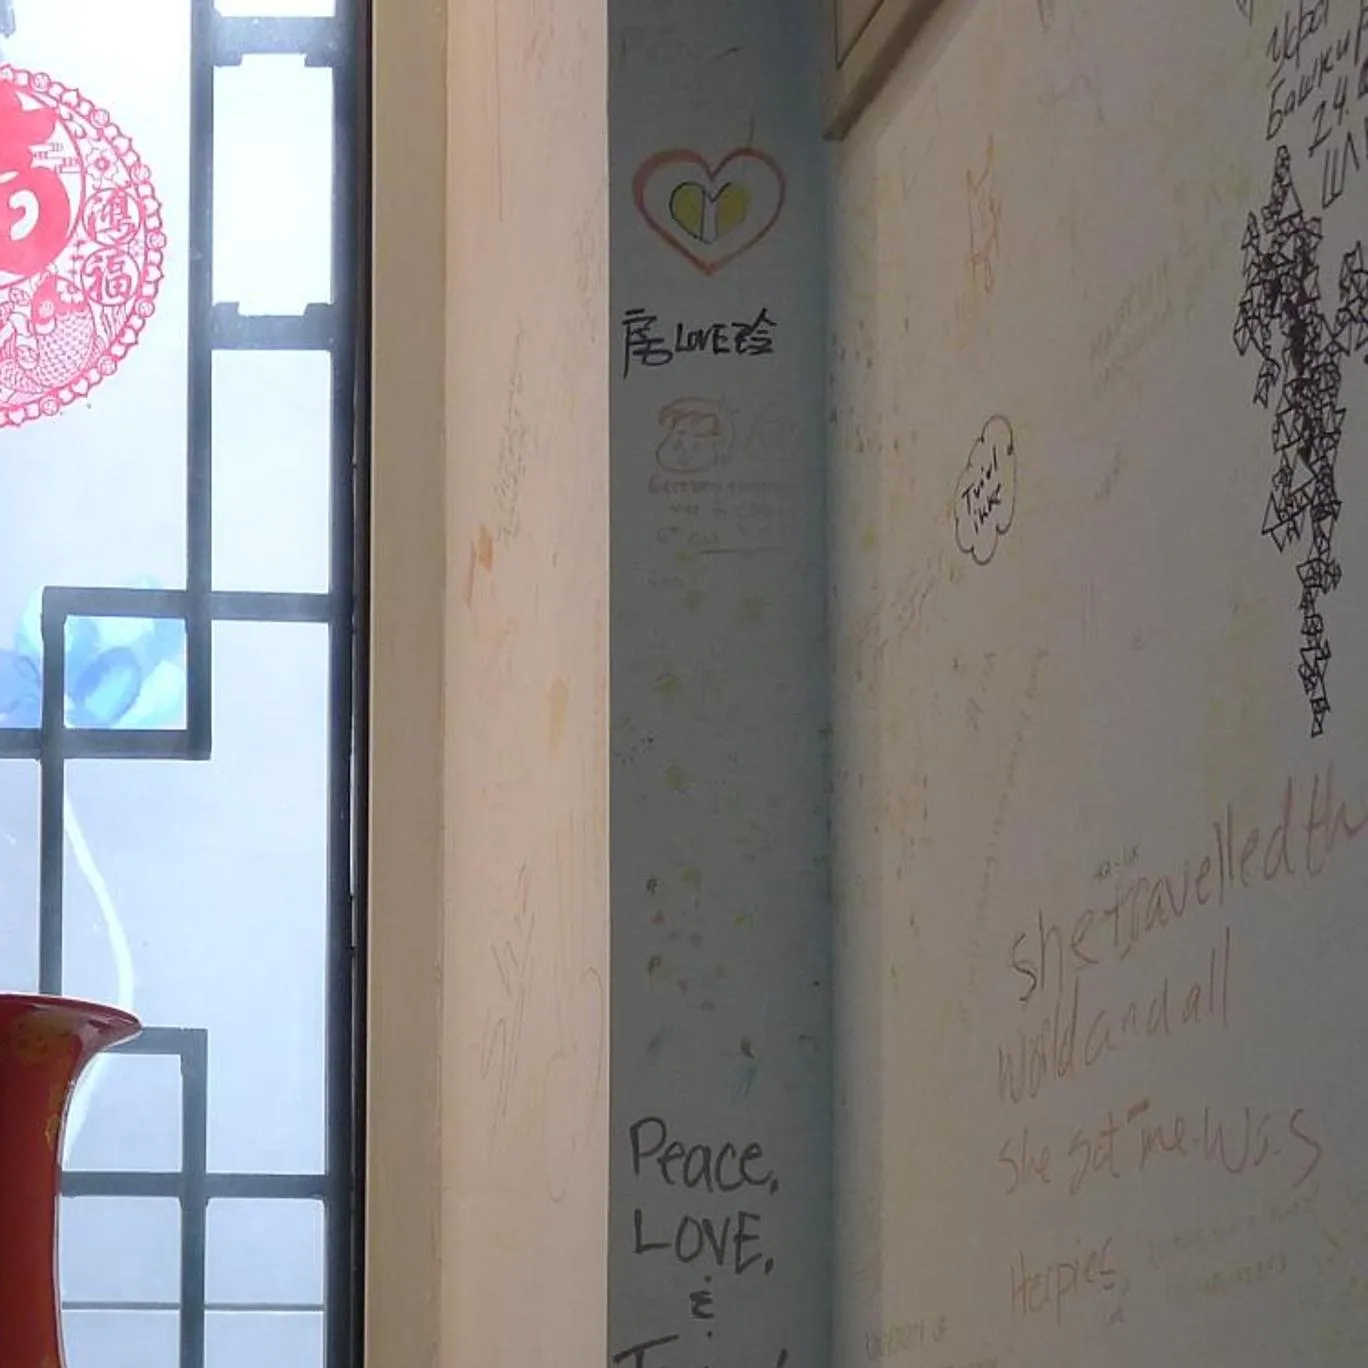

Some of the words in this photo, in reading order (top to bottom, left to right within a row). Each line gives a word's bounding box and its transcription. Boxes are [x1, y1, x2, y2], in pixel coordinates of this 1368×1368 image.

[674, 322, 731, 355] LOVE
[1182, 925, 1231, 1030] all
[632, 1208, 774, 1275] LOVE,
